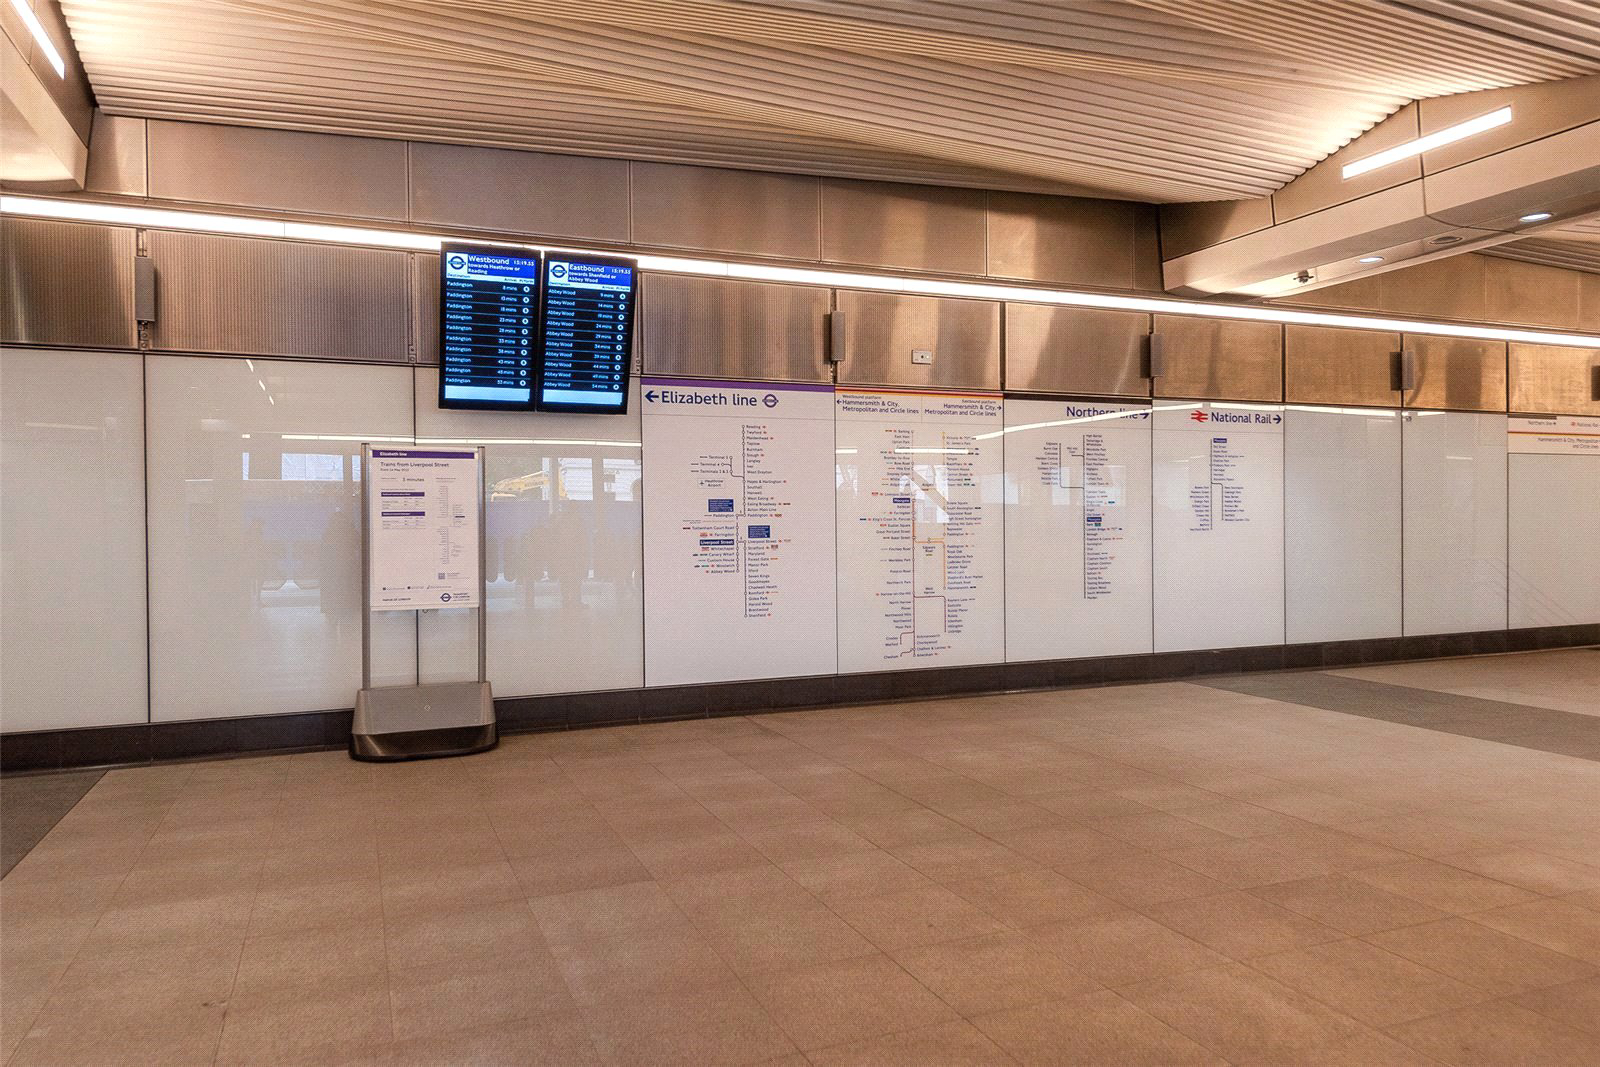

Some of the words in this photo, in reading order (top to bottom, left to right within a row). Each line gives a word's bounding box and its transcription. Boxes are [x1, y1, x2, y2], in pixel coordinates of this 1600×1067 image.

[469, 256, 509, 265] Westbound
[569, 264, 605, 272] Eastbound
[661, 391, 727, 405] Elizabeth
[733, 394, 757, 406] line
[1211, 412, 1251, 423] National
[1255, 413, 1272, 424] Rail
